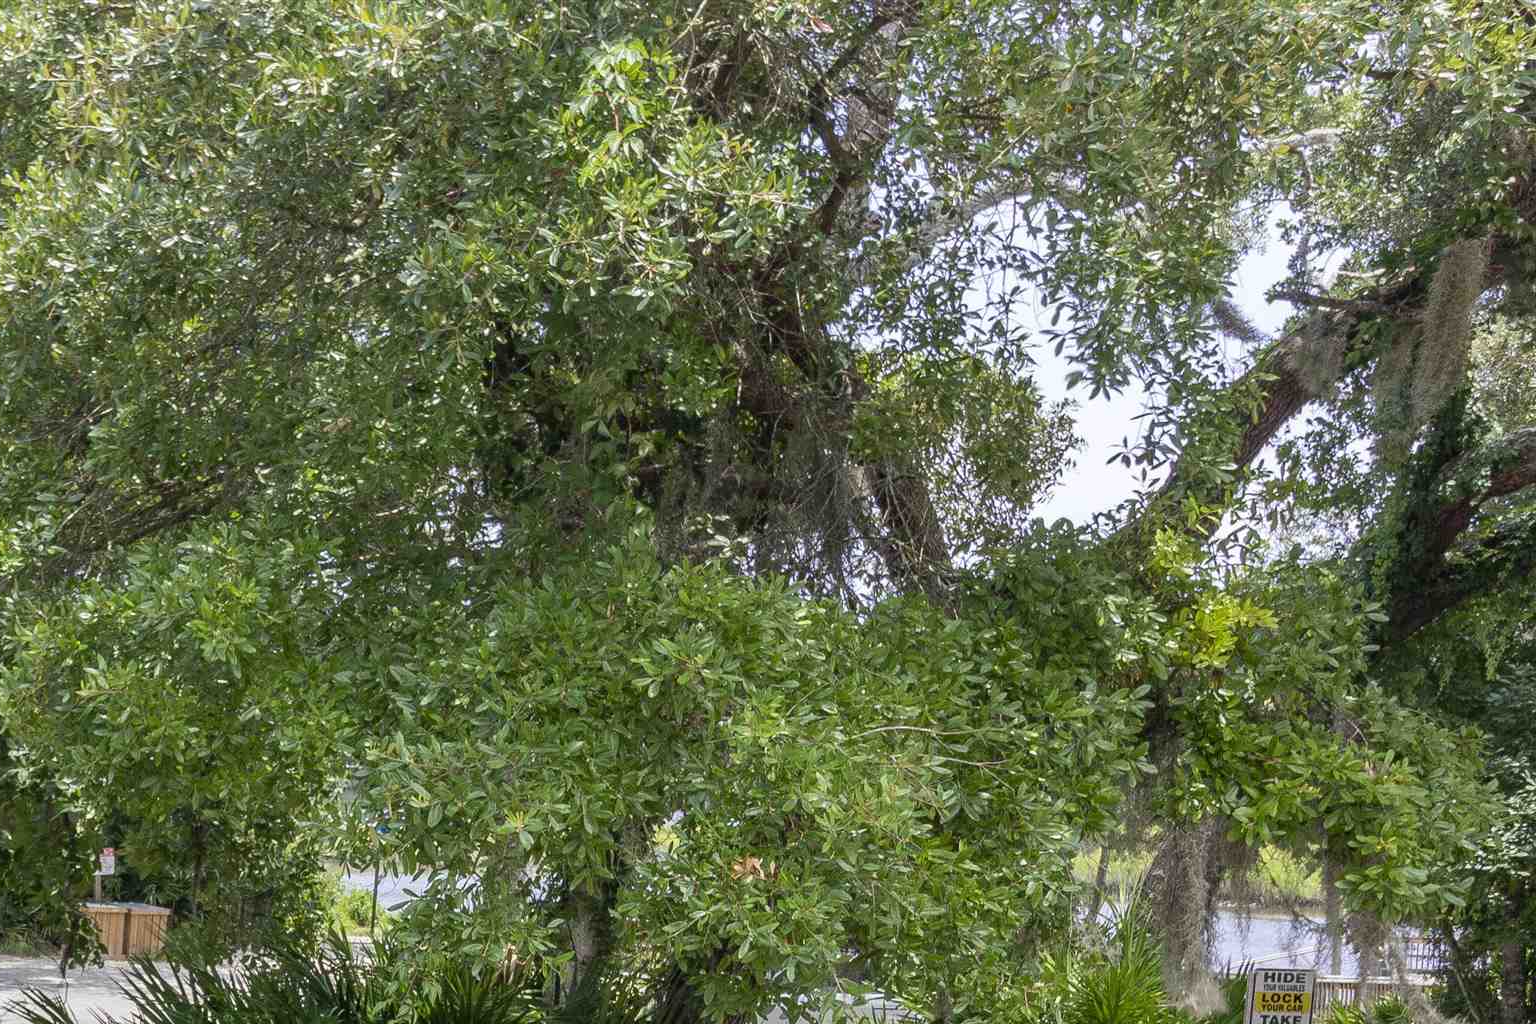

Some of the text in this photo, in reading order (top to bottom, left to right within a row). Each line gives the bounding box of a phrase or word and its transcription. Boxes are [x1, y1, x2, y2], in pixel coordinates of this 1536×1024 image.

[1264, 972, 1306, 983] HIDE
[1262, 993, 1303, 1003] LOCK
[1261, 1004, 1303, 1012] YOUR CAR
